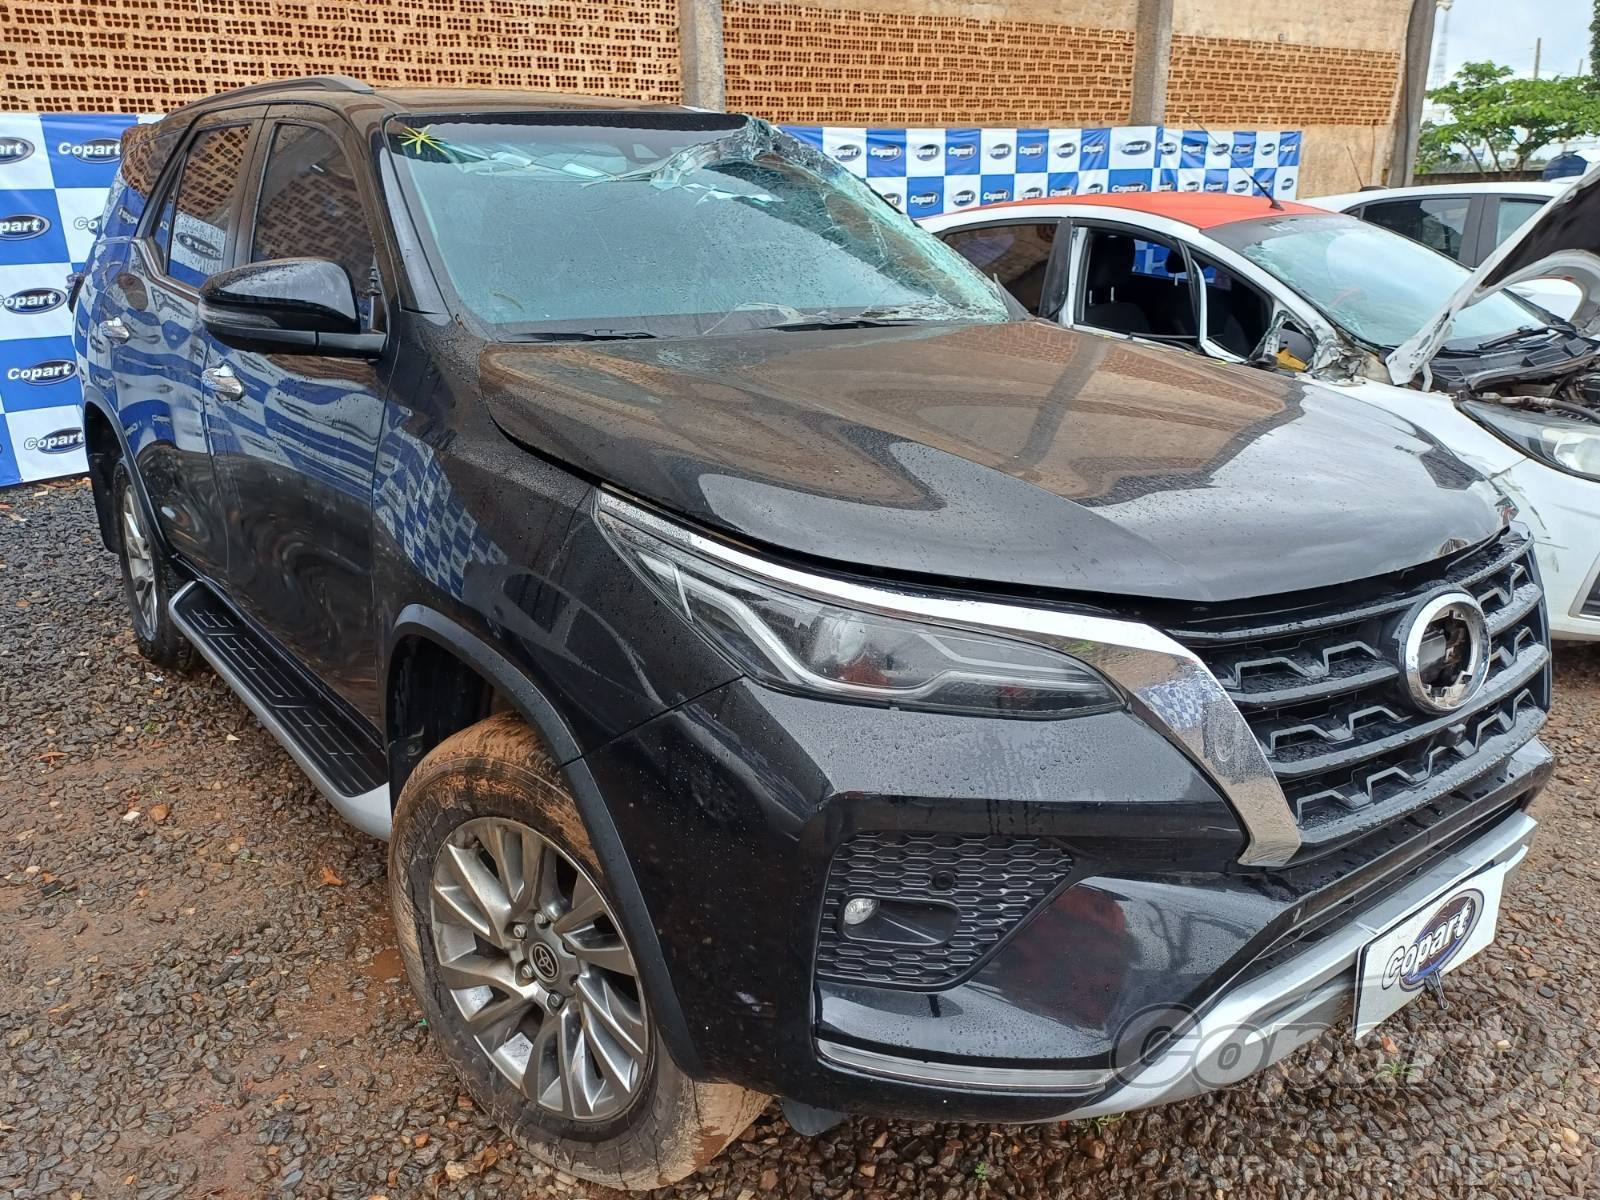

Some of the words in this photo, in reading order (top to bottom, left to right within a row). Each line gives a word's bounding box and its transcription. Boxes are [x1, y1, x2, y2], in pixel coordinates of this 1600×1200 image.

[58, 142, 121, 158] Copart
[7, 362, 72, 380] Copart
[24, 430, 85, 451] Copart
[1382, 896, 1473, 990] Copart
